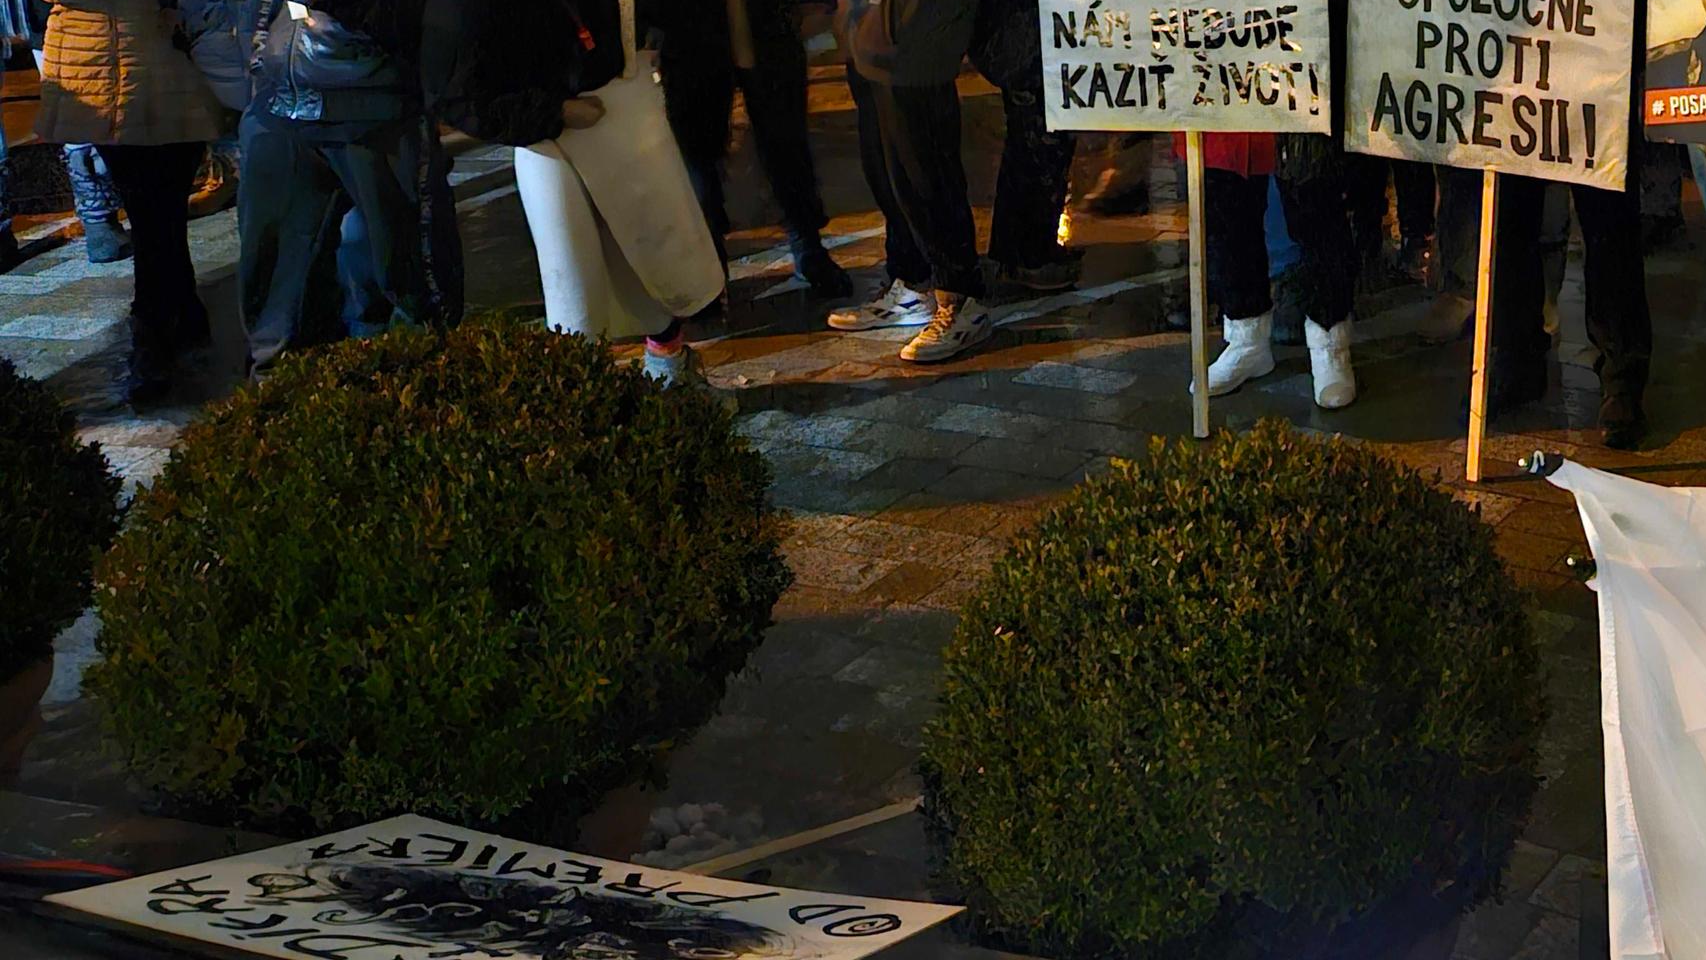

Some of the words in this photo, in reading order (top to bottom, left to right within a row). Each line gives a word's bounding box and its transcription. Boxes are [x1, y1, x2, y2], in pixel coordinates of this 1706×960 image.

[1051, 0, 1132, 50] NÁM
[1150, 5, 1301, 52] NEBUDE
[1415, 20, 1551, 91] PROTI
[1061, 52, 1175, 109] KAZIŤ
[1192, 51, 1320, 115] ŽIVOT!
